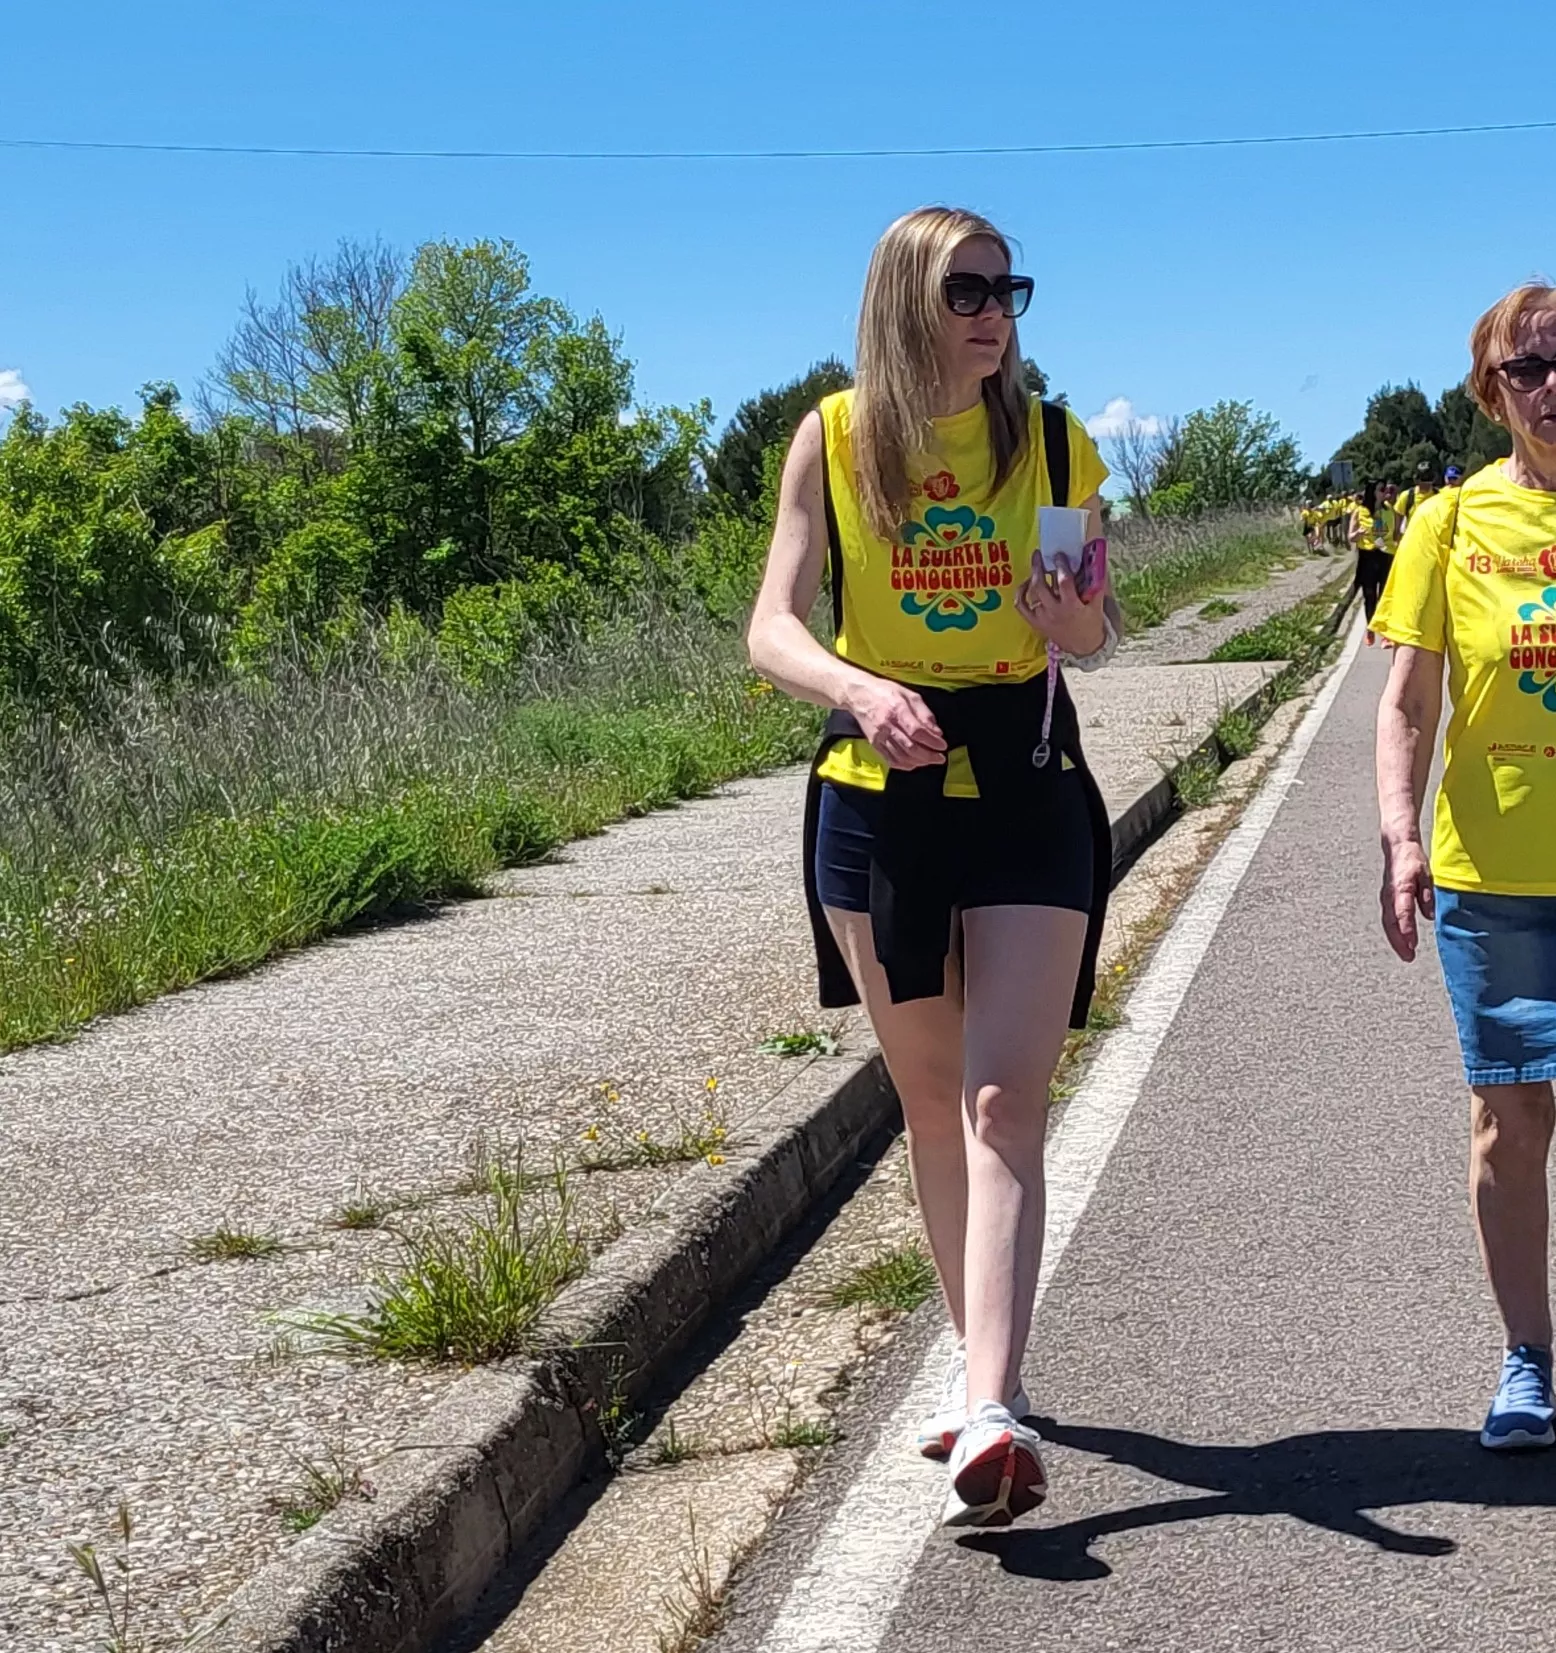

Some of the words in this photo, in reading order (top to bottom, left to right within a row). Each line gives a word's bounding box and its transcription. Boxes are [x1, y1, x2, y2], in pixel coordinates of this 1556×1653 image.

[892, 545, 913, 568] LA
[919, 542, 983, 568] SUERTE
[987, 540, 1010, 564] DE
[1466, 552, 1492, 575] 13
[891, 563, 1013, 590] CONOCERNOS
[1511, 624, 1533, 645] LA
